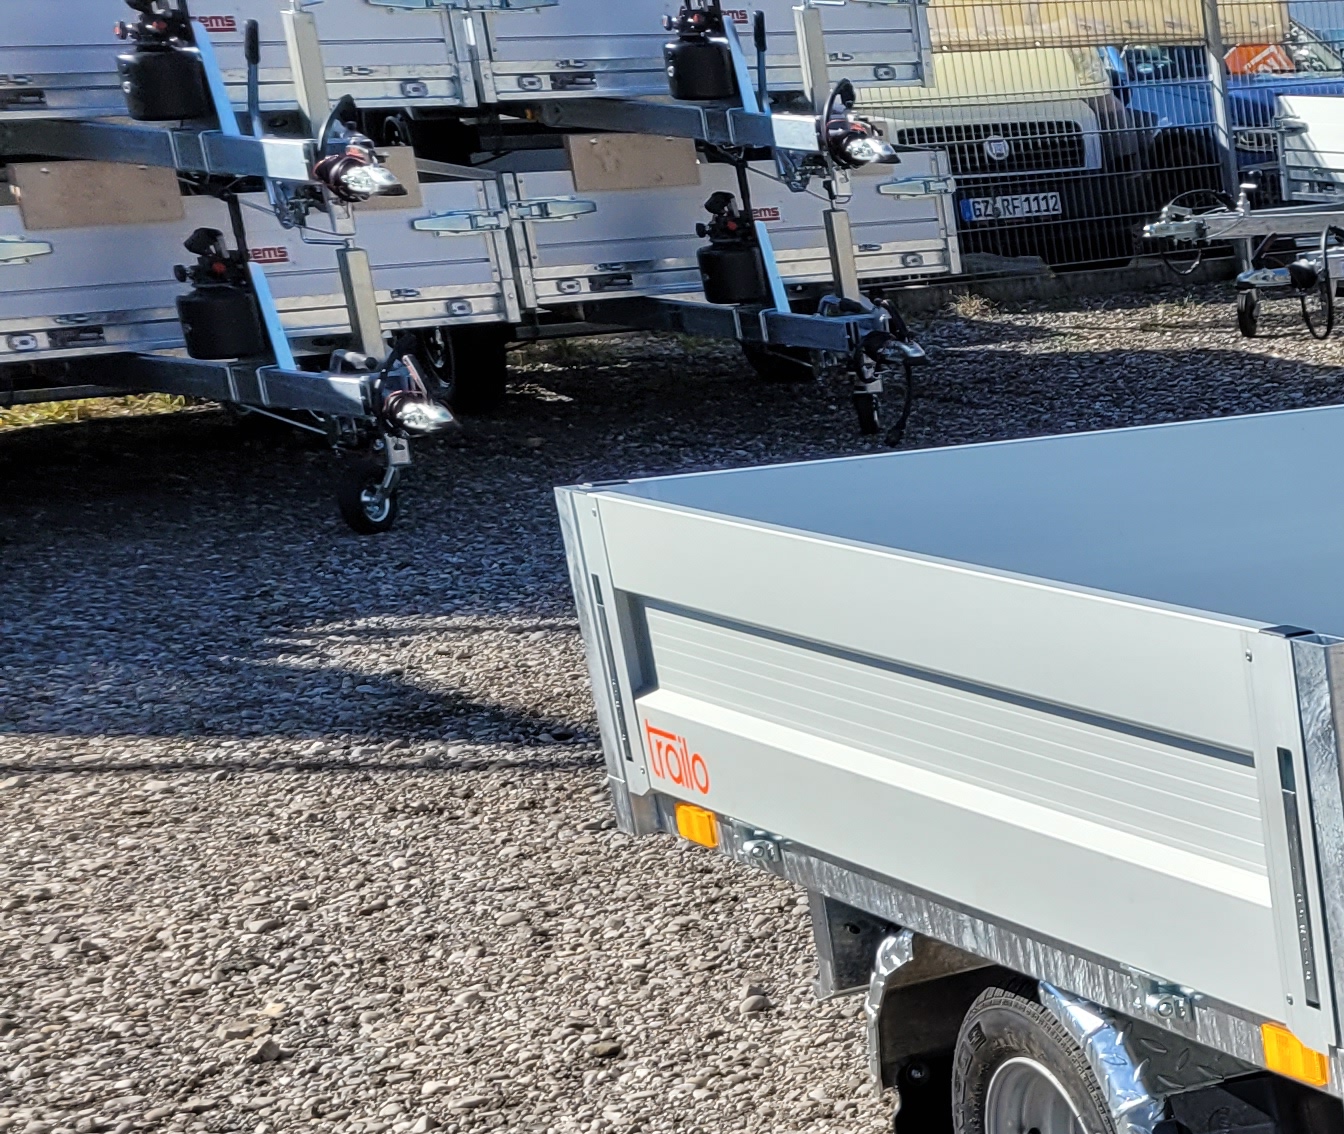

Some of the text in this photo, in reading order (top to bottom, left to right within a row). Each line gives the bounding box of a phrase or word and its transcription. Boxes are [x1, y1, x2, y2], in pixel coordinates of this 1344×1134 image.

[972, 194, 1060, 218] GZ RF 1112
